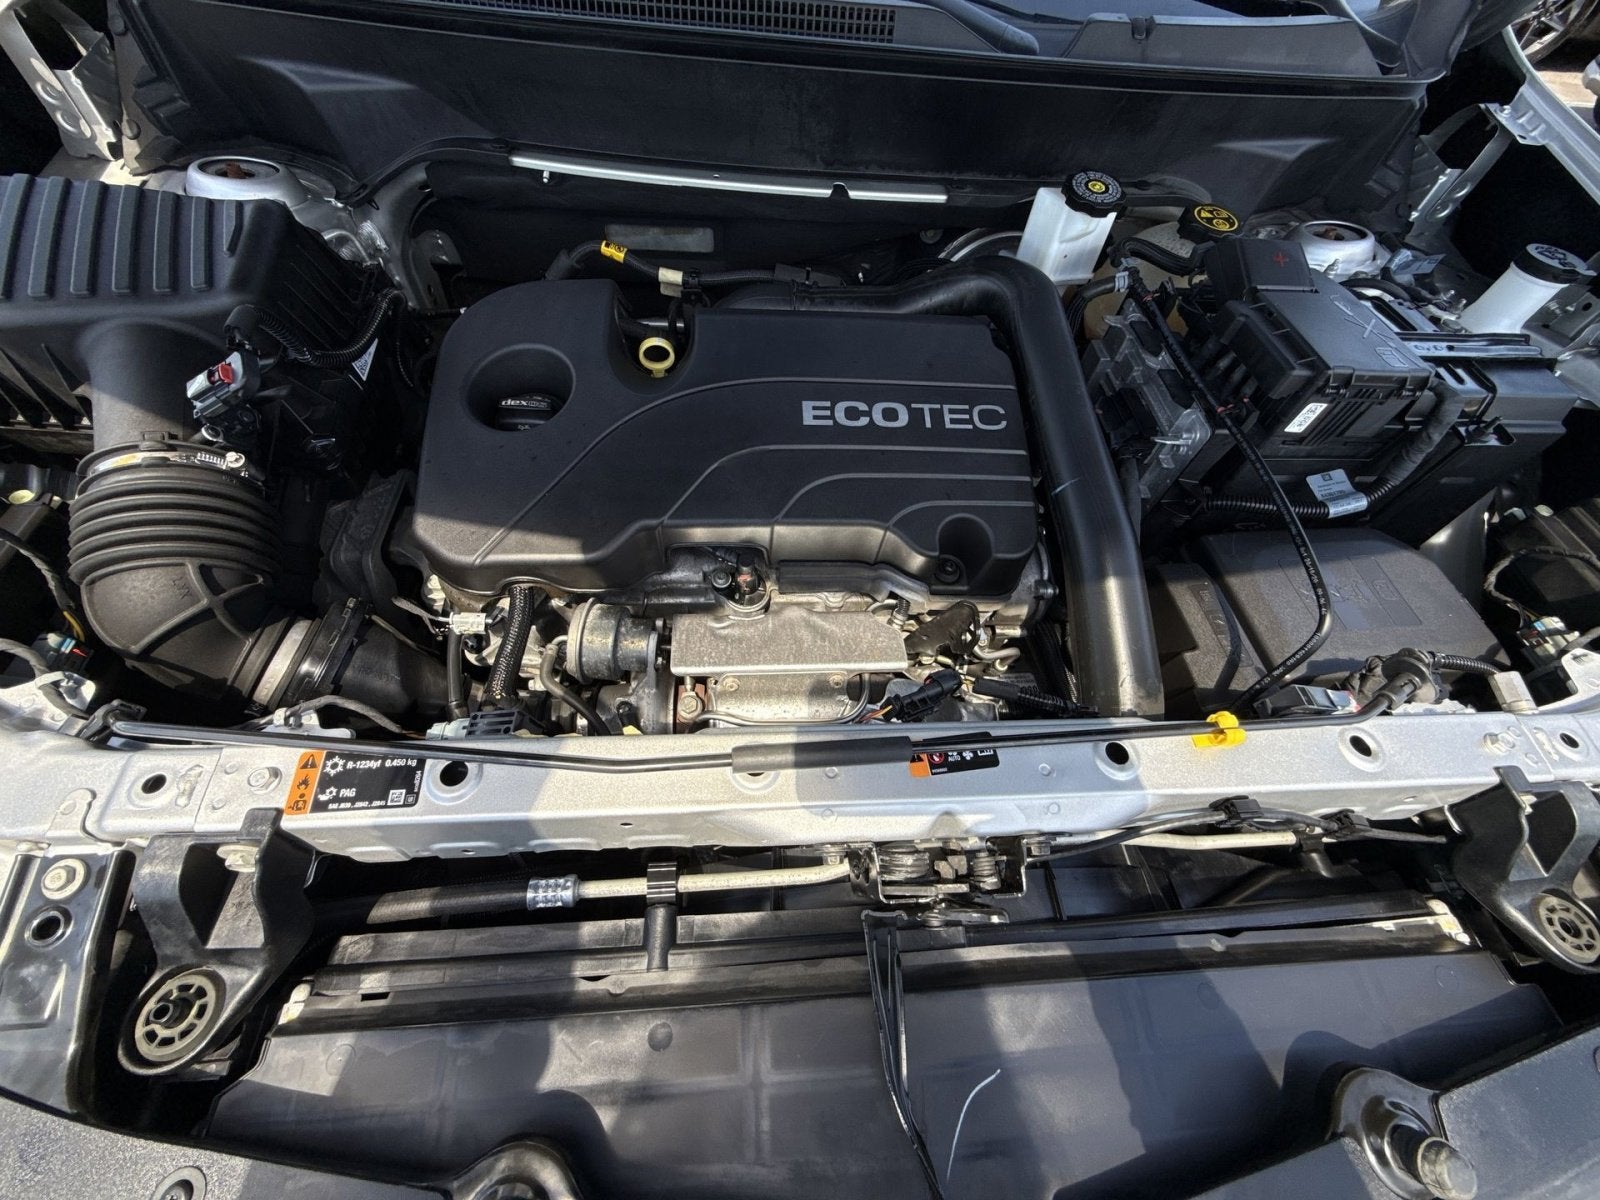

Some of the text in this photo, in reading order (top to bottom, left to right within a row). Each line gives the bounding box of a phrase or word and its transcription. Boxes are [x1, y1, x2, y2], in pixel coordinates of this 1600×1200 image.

[802, 400, 1008, 431] ECOTEC
[346, 759, 417, 770] R-1234yf 0.450 kg
[339, 788, 356, 798] PAG
